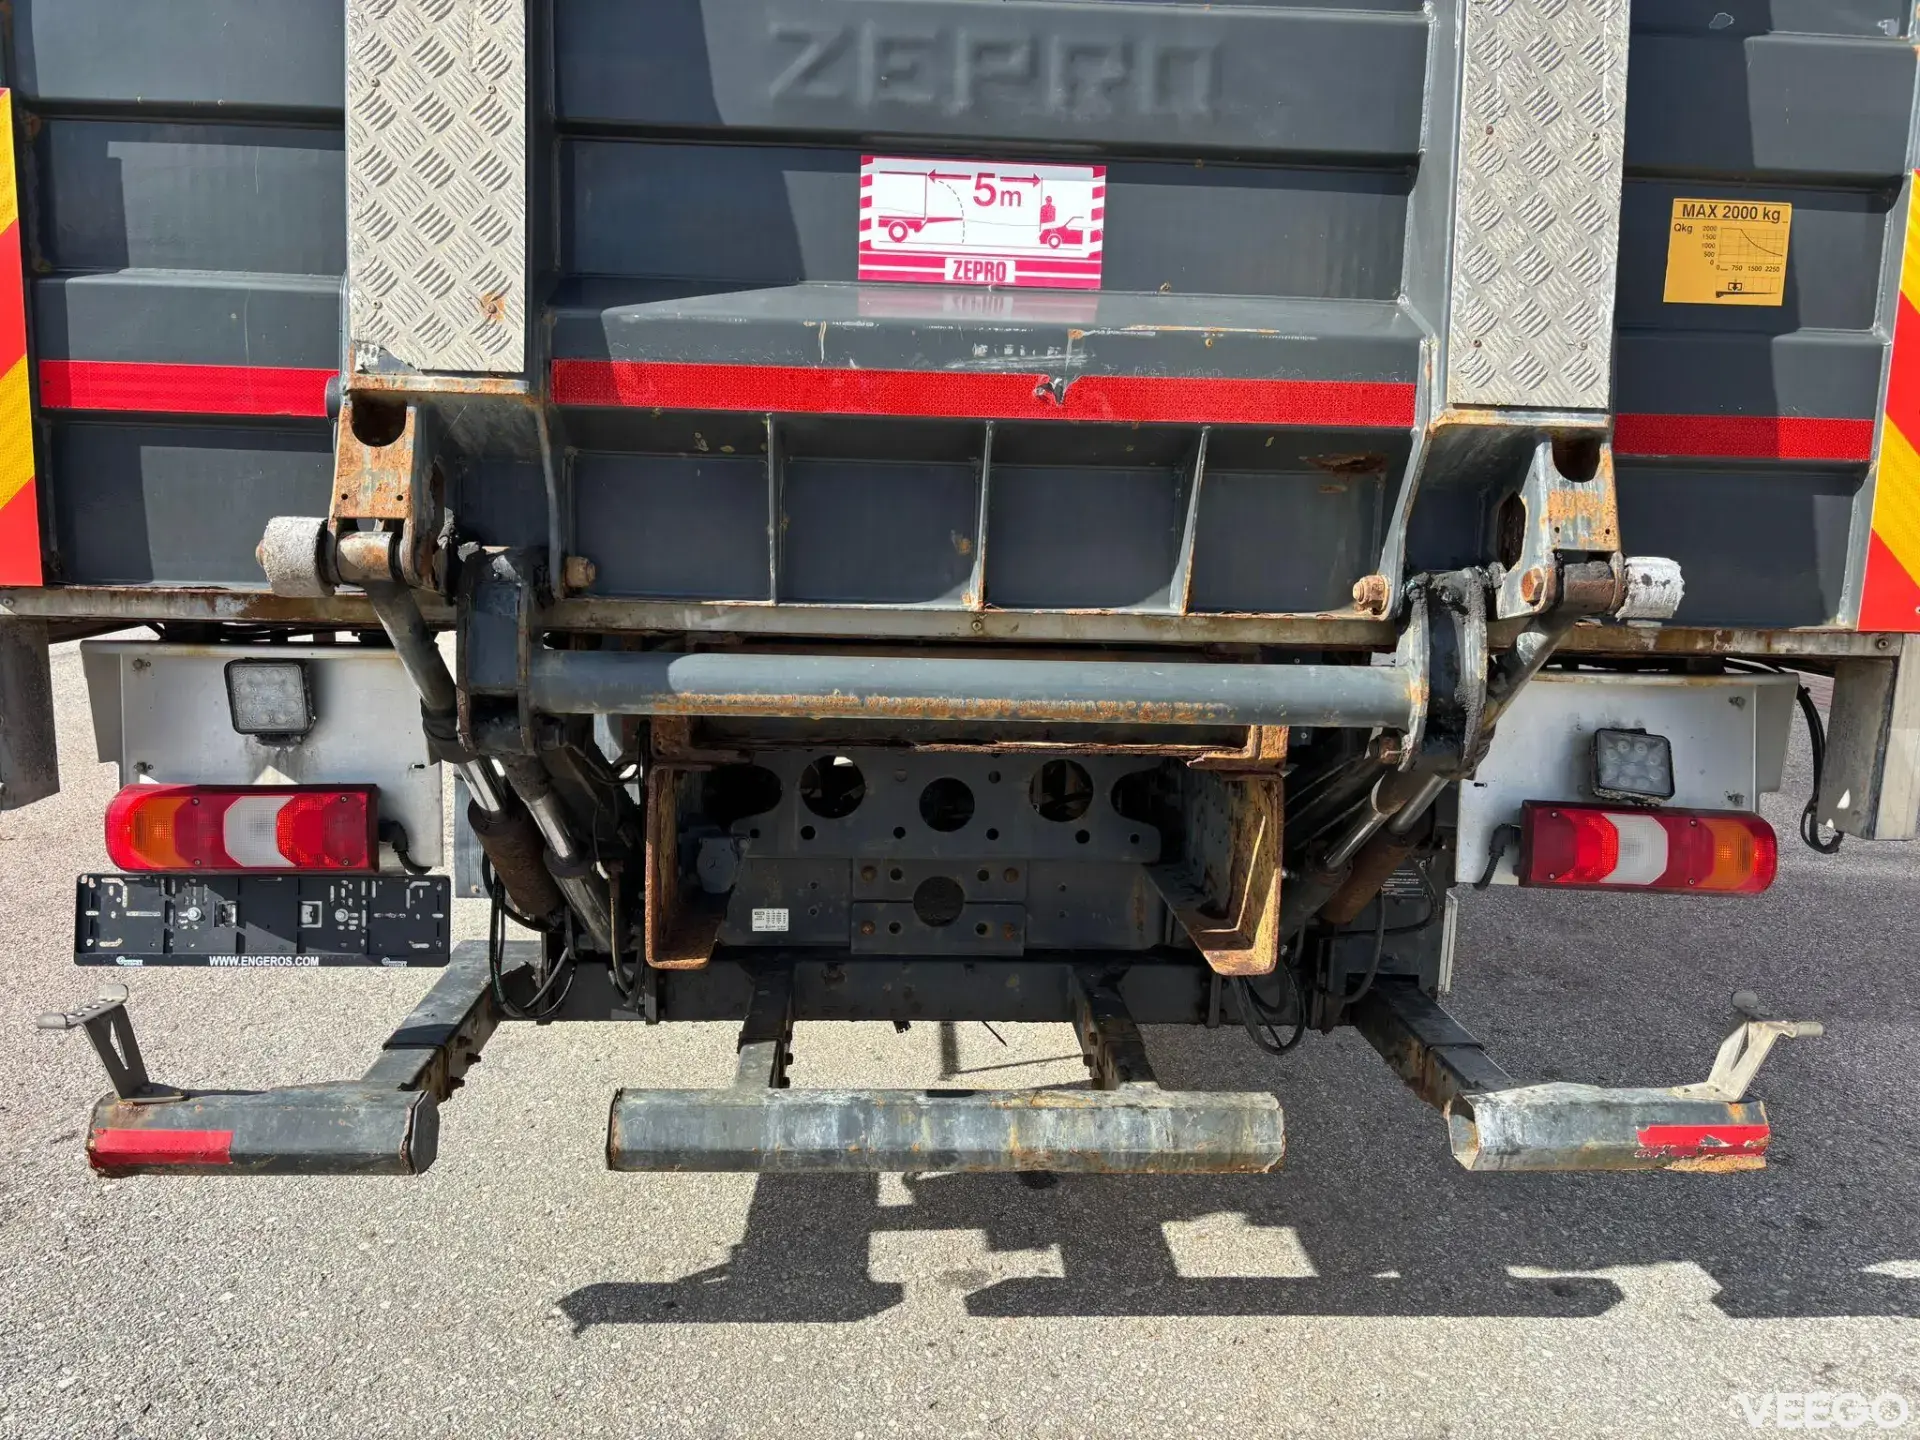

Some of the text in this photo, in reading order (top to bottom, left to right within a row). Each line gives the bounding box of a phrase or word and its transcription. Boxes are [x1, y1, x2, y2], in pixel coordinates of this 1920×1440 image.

[1682, 204, 1781, 224] MAX 2000 kg
[1674, 223, 1693, 234] Qkg
[953, 260, 1007, 281] ZEPRO
[209, 955, 319, 967] WWW.ENGEROS.COM
